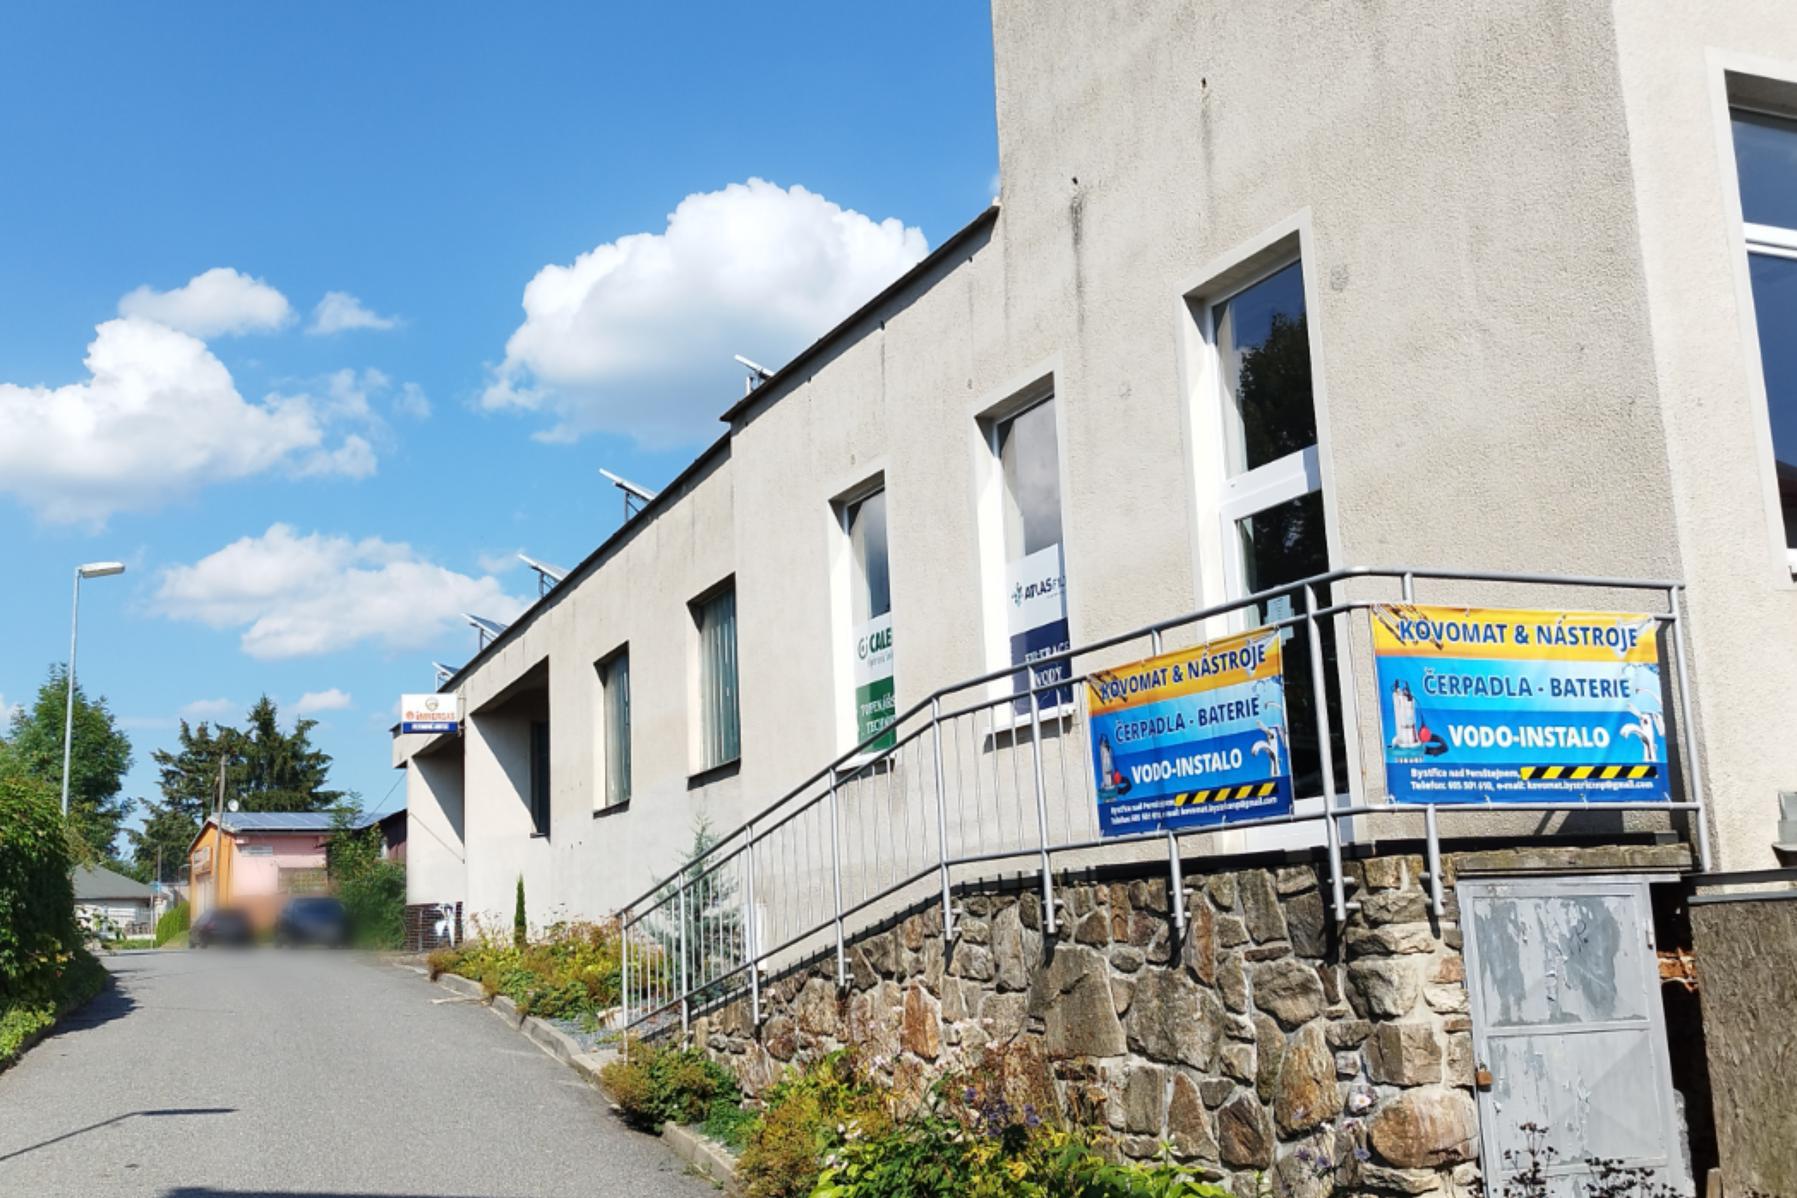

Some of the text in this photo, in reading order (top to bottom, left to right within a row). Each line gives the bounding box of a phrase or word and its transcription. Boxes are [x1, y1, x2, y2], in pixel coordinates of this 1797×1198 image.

[1399, 620, 1637, 652] KOVOMAT & NÁSTROJE
[1100, 643, 1266, 700] KOVOMAT & NÁSTROJE
[1424, 667, 1532, 697] ČERPADLA
[1551, 678, 1630, 698] BATERIE
[1115, 713, 1185, 743] ČERPADLA
[1198, 698, 1259, 726] BATERIE
[1448, 725, 1610, 748] VODO-INSTALO
[1132, 748, 1242, 784] VODO-INSTALO
